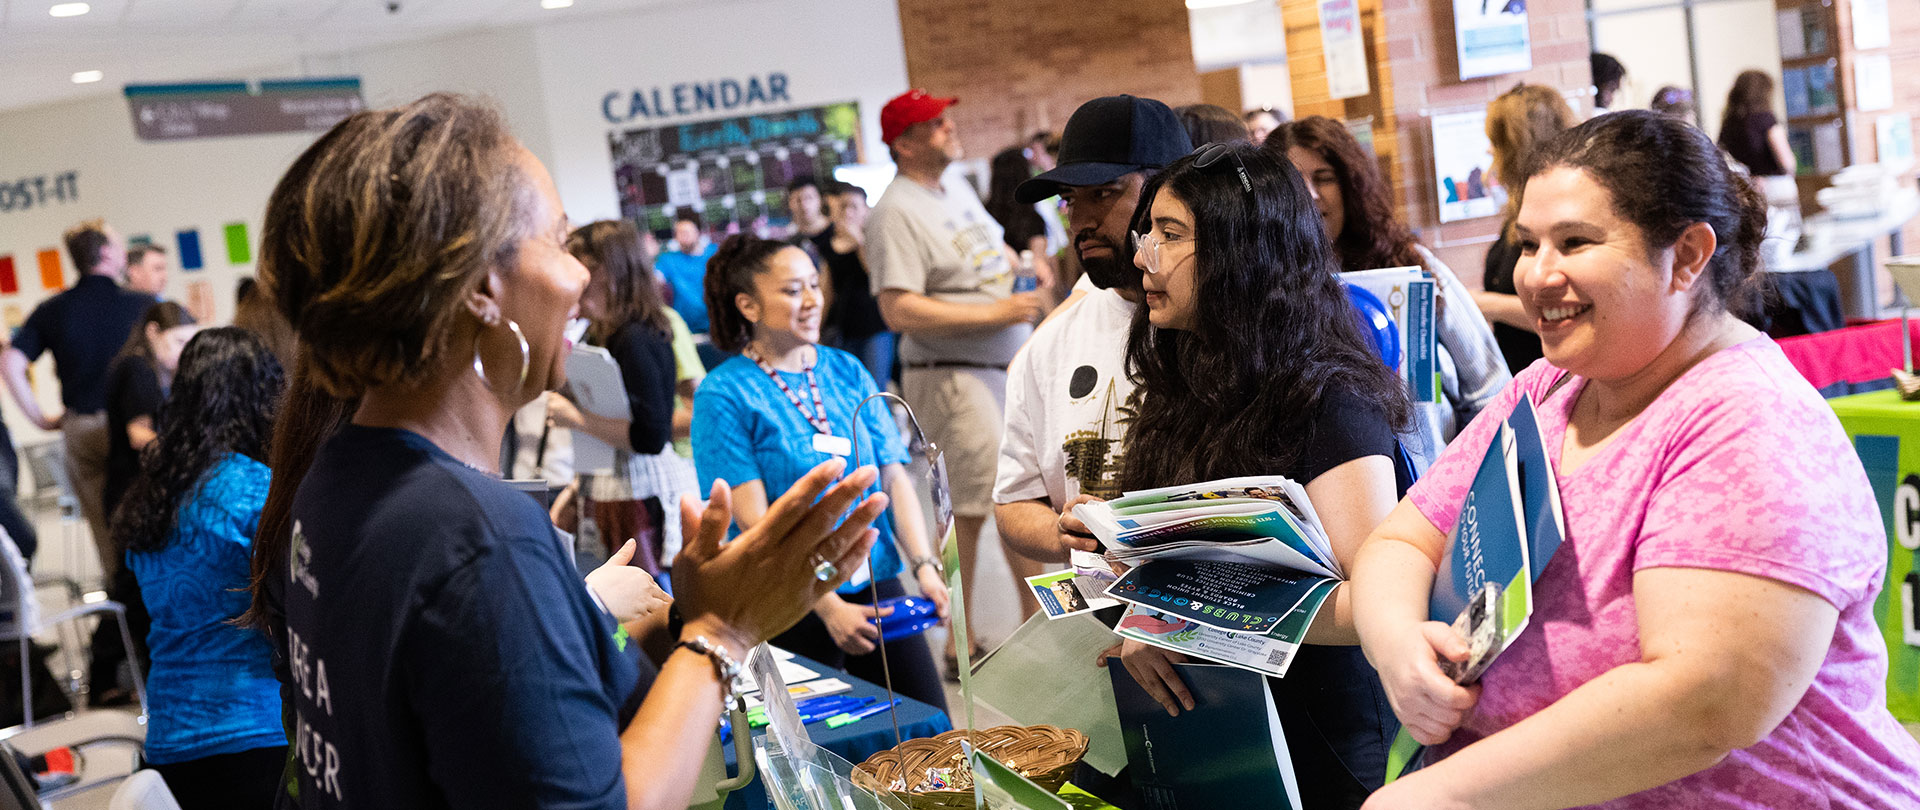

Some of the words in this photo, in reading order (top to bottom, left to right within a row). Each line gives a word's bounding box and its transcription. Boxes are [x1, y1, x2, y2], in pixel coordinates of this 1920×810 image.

[603, 73, 790, 123] CALENDAR
[0, 170, 78, 213] OST-IT
[1125, 530, 1164, 542] Thank
[1165, 525, 1189, 533] you
[1190, 519, 1210, 527] for
[1211, 517, 1256, 525] joining
[1467, 491, 1486, 588] CONNEC
[1175, 572, 1193, 580] CLUB
[1198, 574, 1242, 589] ENGINEERING
[1219, 576, 1248, 587] FANDOM
[1165, 583, 1190, 593] UNION
[1179, 583, 1201, 592] BYTES
[1194, 578, 1223, 589] JUSTICE
[1201, 585, 1222, 593] CHESS
[1190, 591, 1221, 603] STUDENT
[1209, 591, 1238, 602] BOARDS
[1223, 586, 1255, 598] CRIMINAL
[1222, 599, 1244, 609] BLACK
[1902, 582, 1920, 646] L
[1247, 636, 1265, 644] County
[316, 658, 333, 716] A
[296, 709, 342, 801] NCER
